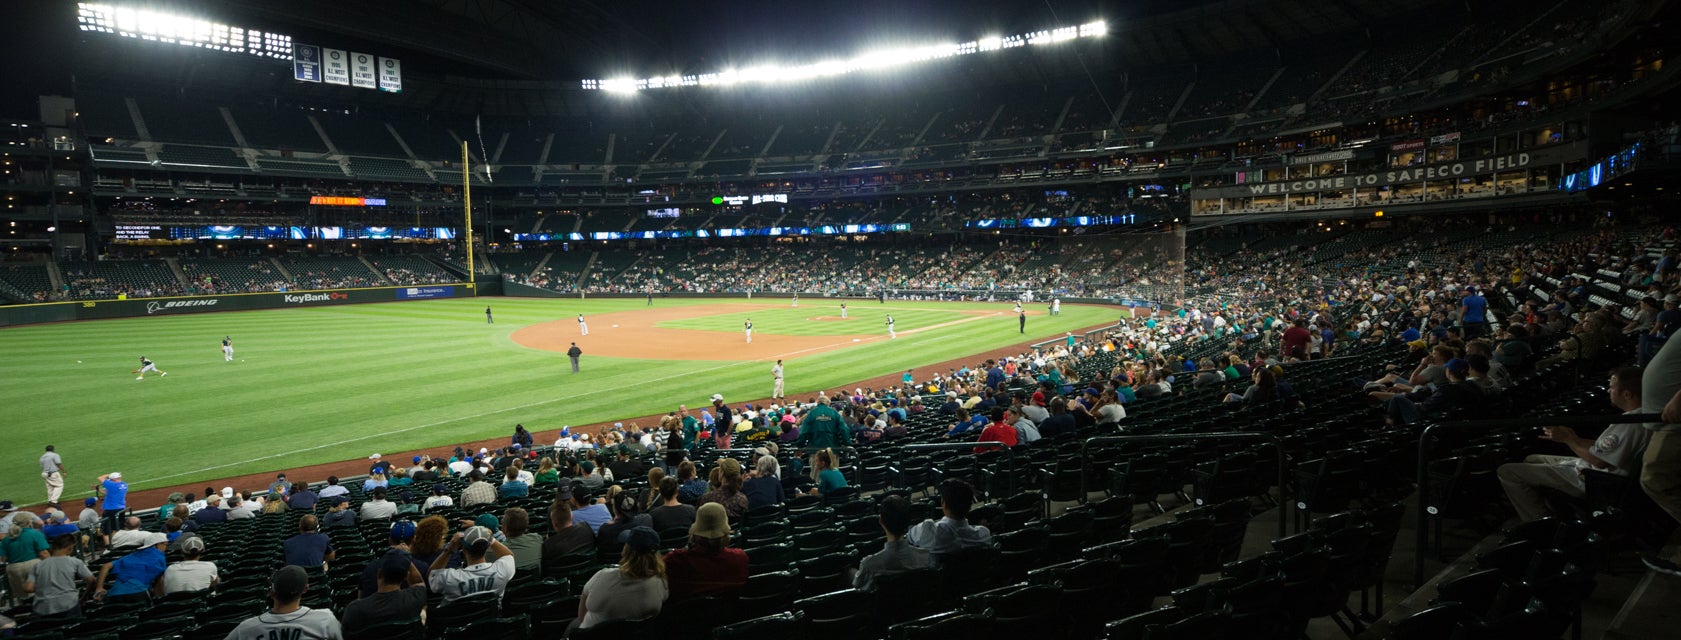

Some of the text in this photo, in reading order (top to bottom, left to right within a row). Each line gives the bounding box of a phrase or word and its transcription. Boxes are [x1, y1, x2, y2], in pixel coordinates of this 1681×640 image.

[1250, 153, 1530, 194] WELCOME TO SAFECO FIELD
[165, 299, 218, 308] BOEING
[285, 293, 330, 303] KeyBank
[459, 577, 494, 596] CANO
